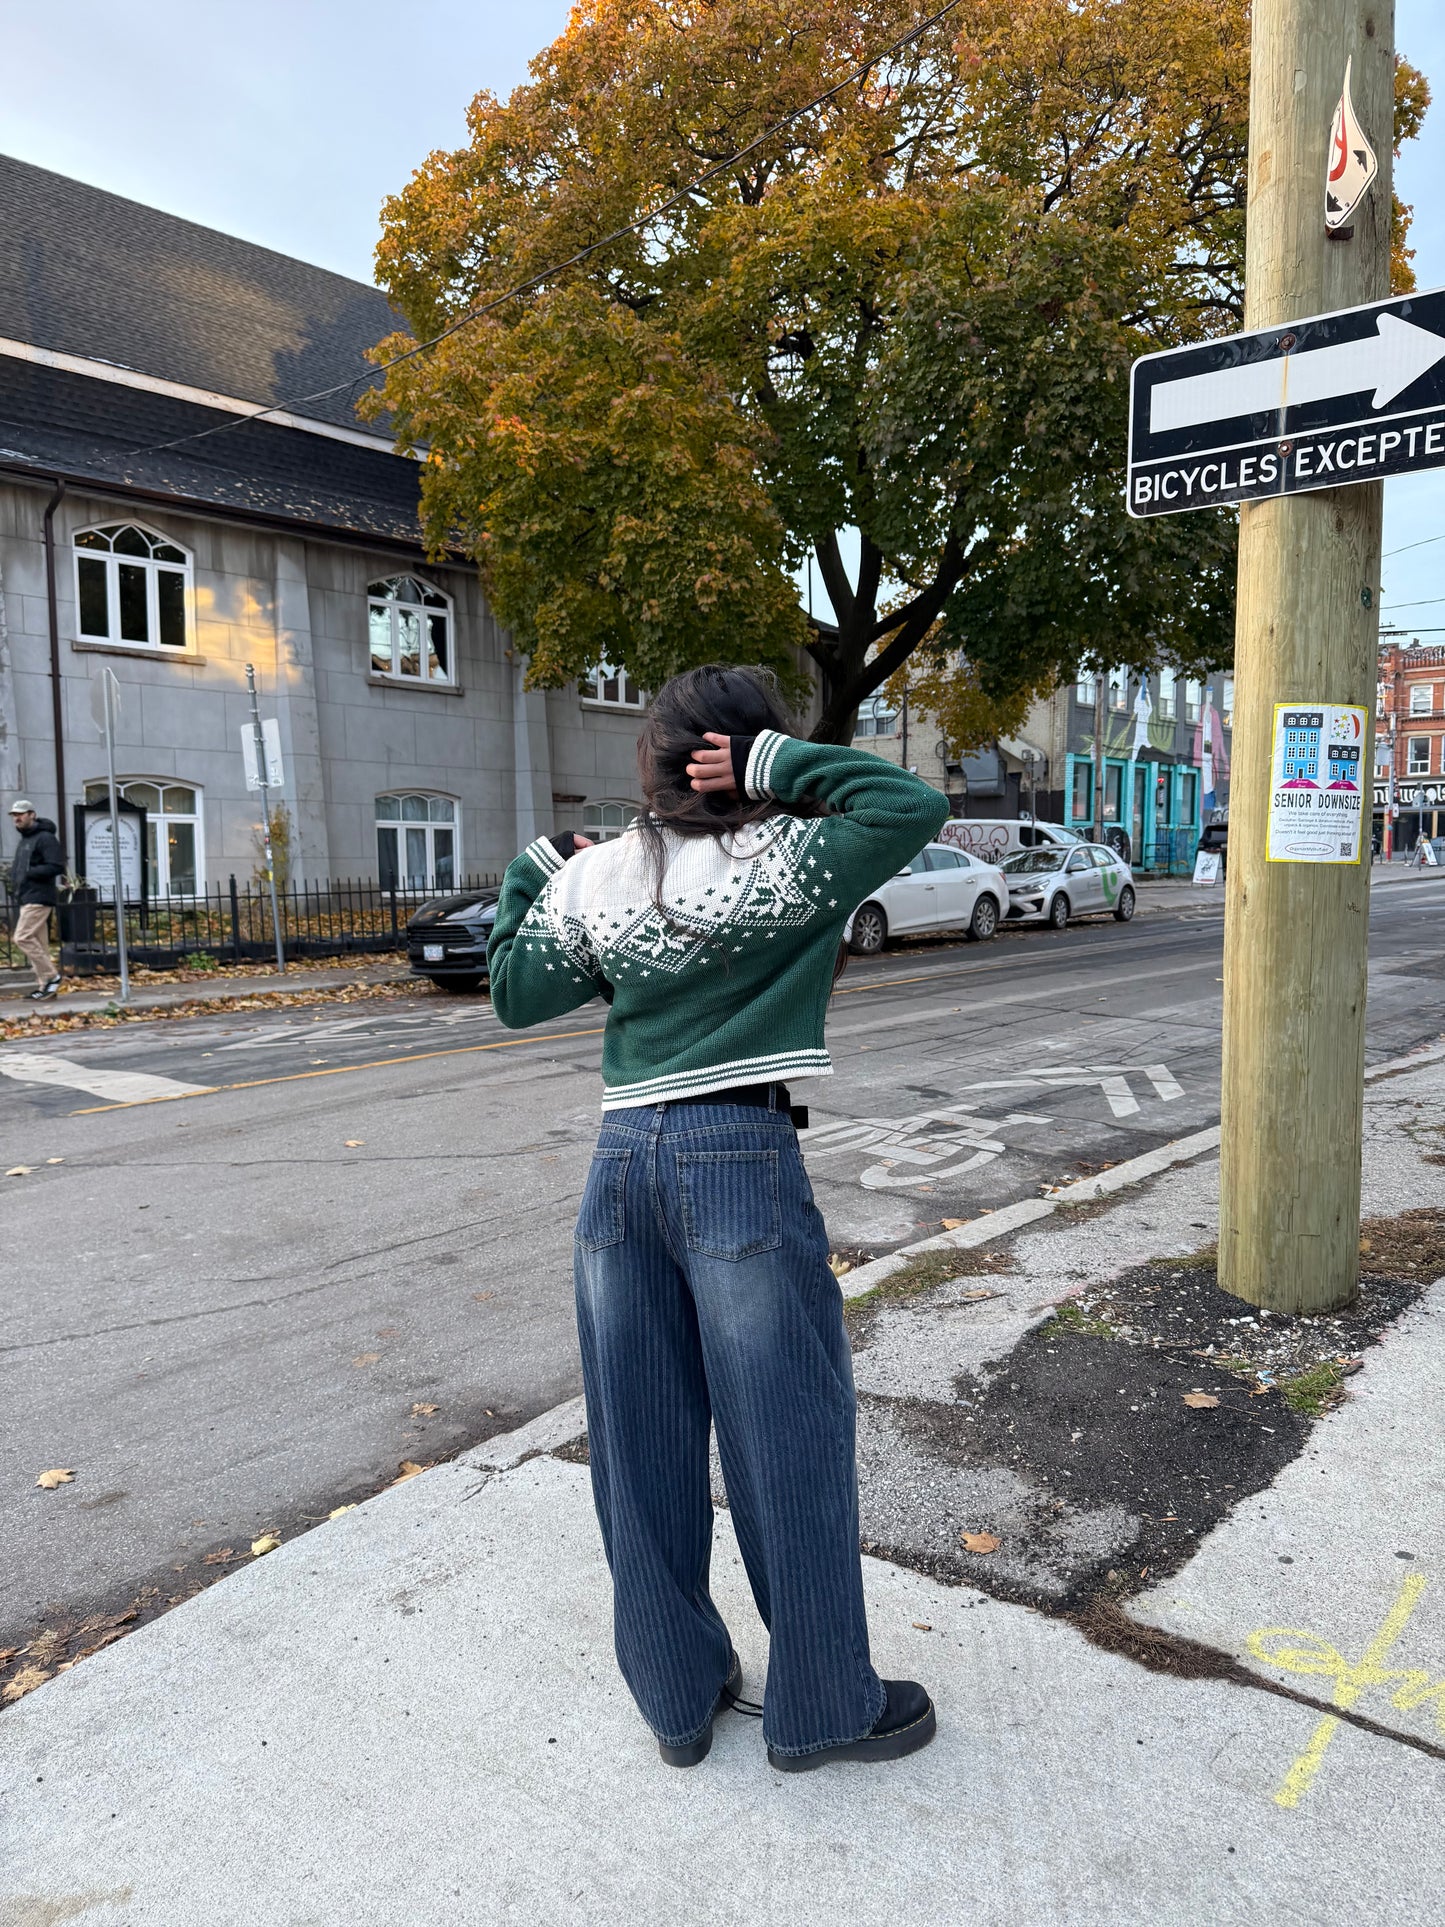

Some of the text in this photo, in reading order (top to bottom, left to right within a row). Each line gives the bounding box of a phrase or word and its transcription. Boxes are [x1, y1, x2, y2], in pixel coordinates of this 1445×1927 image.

[1134, 422, 1445, 505] BICYCLES EXCEPTE
[1274, 793, 1361, 810] SENIOR DOWNSIZE
